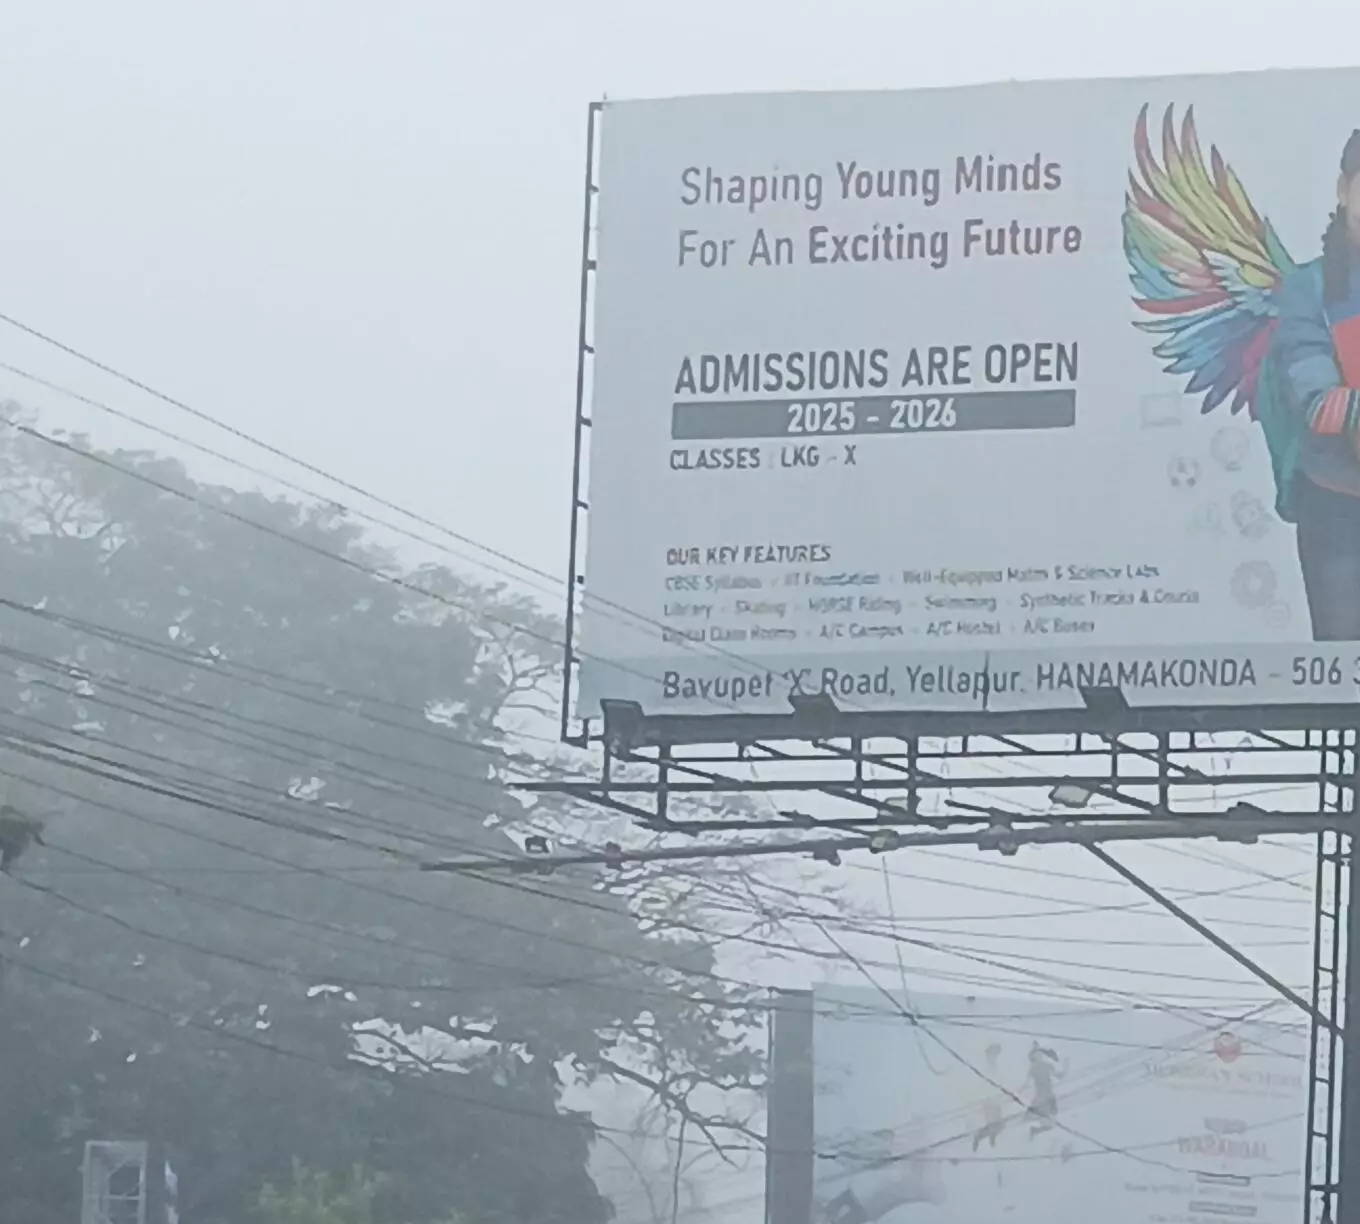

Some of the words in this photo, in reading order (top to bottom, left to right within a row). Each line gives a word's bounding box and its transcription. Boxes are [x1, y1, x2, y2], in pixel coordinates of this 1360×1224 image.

[680, 164, 823, 212] Shaping
[836, 160, 940, 205] Young
[955, 152, 1063, 194] Minds
[678, 228, 736, 266] For
[748, 229, 794, 265] An
[808, 222, 950, 268] Exciting
[963, 218, 1083, 258] Future
[674, 349, 889, 395] ADMISSIONS
[901, 345, 972, 388] ARE
[983, 341, 1079, 382] OPEN
[786, 402, 856, 433] 2025
[890, 398, 957, 428] 2026
[670, 447, 761, 470] CLASSES
[781, 445, 820, 467] LKG
[844, 444, 857, 465] X
[666, 548, 700, 565] OUR
[706, 547, 738, 564] KEY
[743, 544, 831, 563] FEATURES
[1036, 658, 1257, 690] HANAMAKONDA
[1292, 656, 1343, 686] 506
